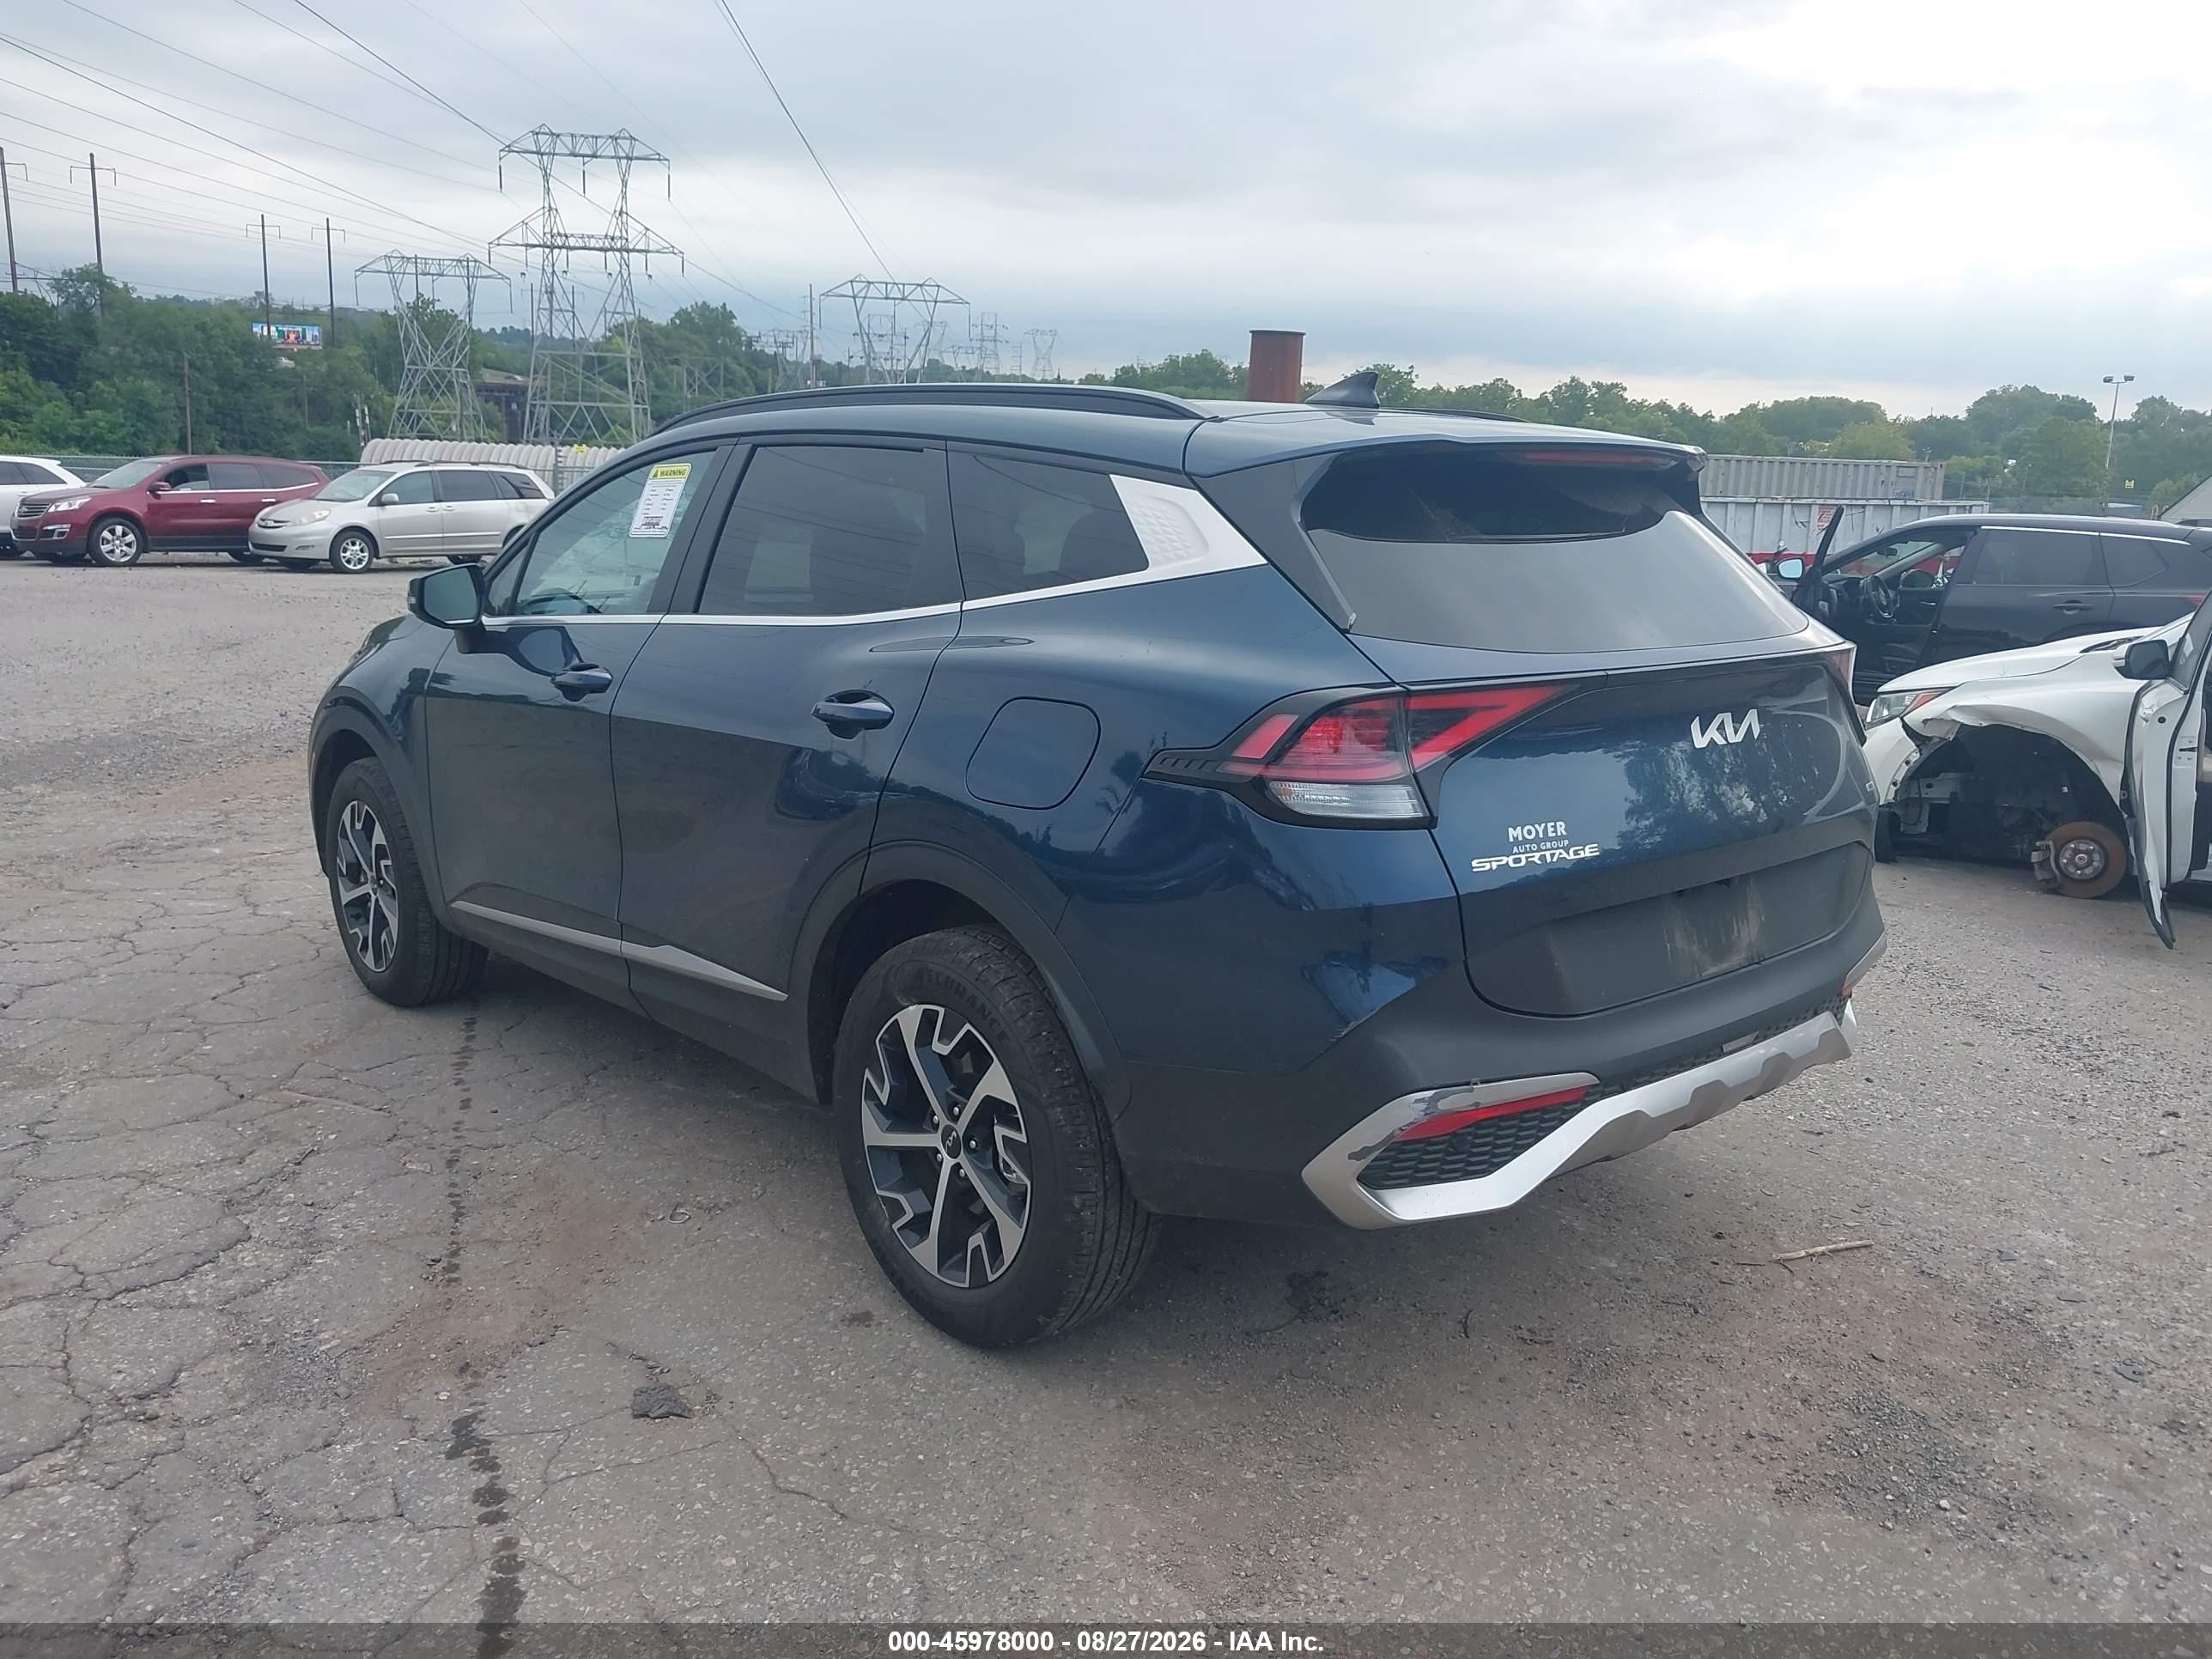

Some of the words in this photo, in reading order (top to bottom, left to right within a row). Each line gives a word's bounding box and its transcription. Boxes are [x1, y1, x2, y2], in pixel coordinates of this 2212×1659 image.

[1690, 709, 1760, 749] KIA
[1508, 821, 1567, 842] MOYER
[1471, 843, 1601, 872] SPORTAGE
[1512, 843, 1537, 854] AUTO
[1540, 839, 1569, 850] GROUP
[915, 967, 1009, 1044] ASSURANCE
